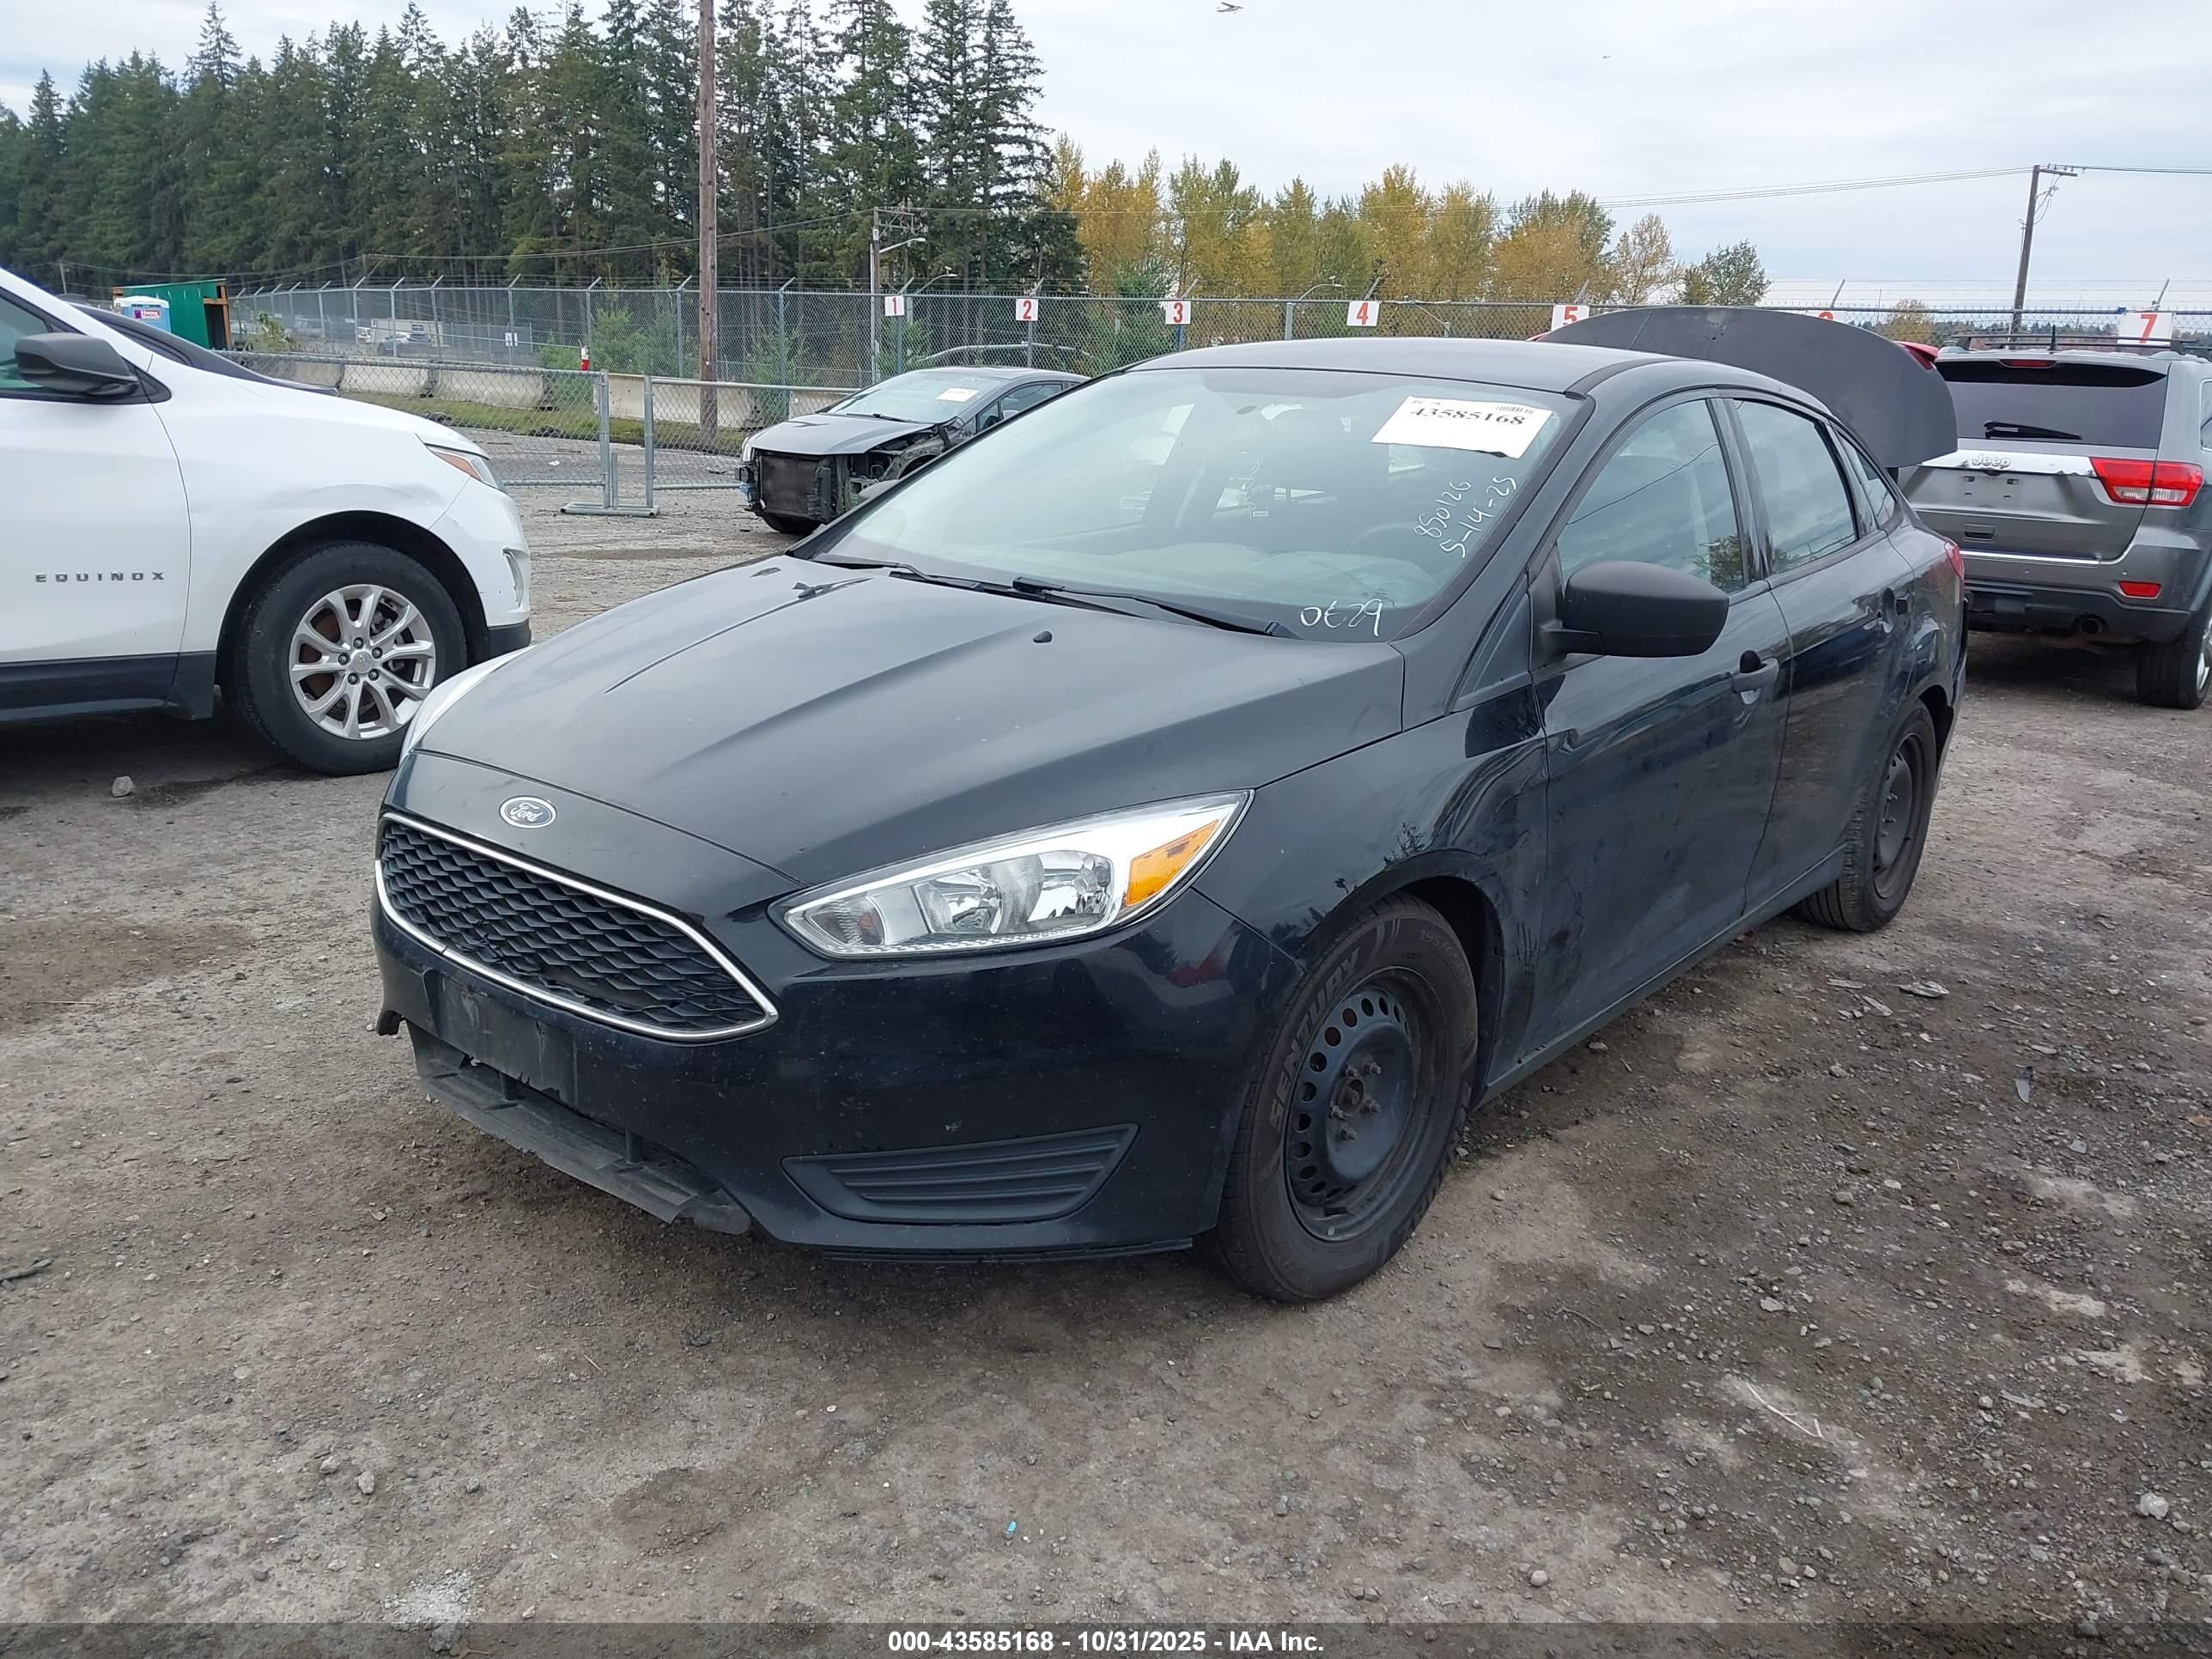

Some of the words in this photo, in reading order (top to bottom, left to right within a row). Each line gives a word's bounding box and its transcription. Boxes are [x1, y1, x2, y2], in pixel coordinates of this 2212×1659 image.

[891, 297, 898, 316] 1
[1022, 300, 1032, 320] 2
[1172, 302, 1184, 324] 3
[1355, 302, 1369, 325] 4
[1563, 306, 1578, 326] 5
[2138, 313, 2158, 344] 7
[1410, 407, 1527, 427] 43585168
[1972, 453, 2012, 470] Jeep
[34, 570, 165, 583] EQUINOX
